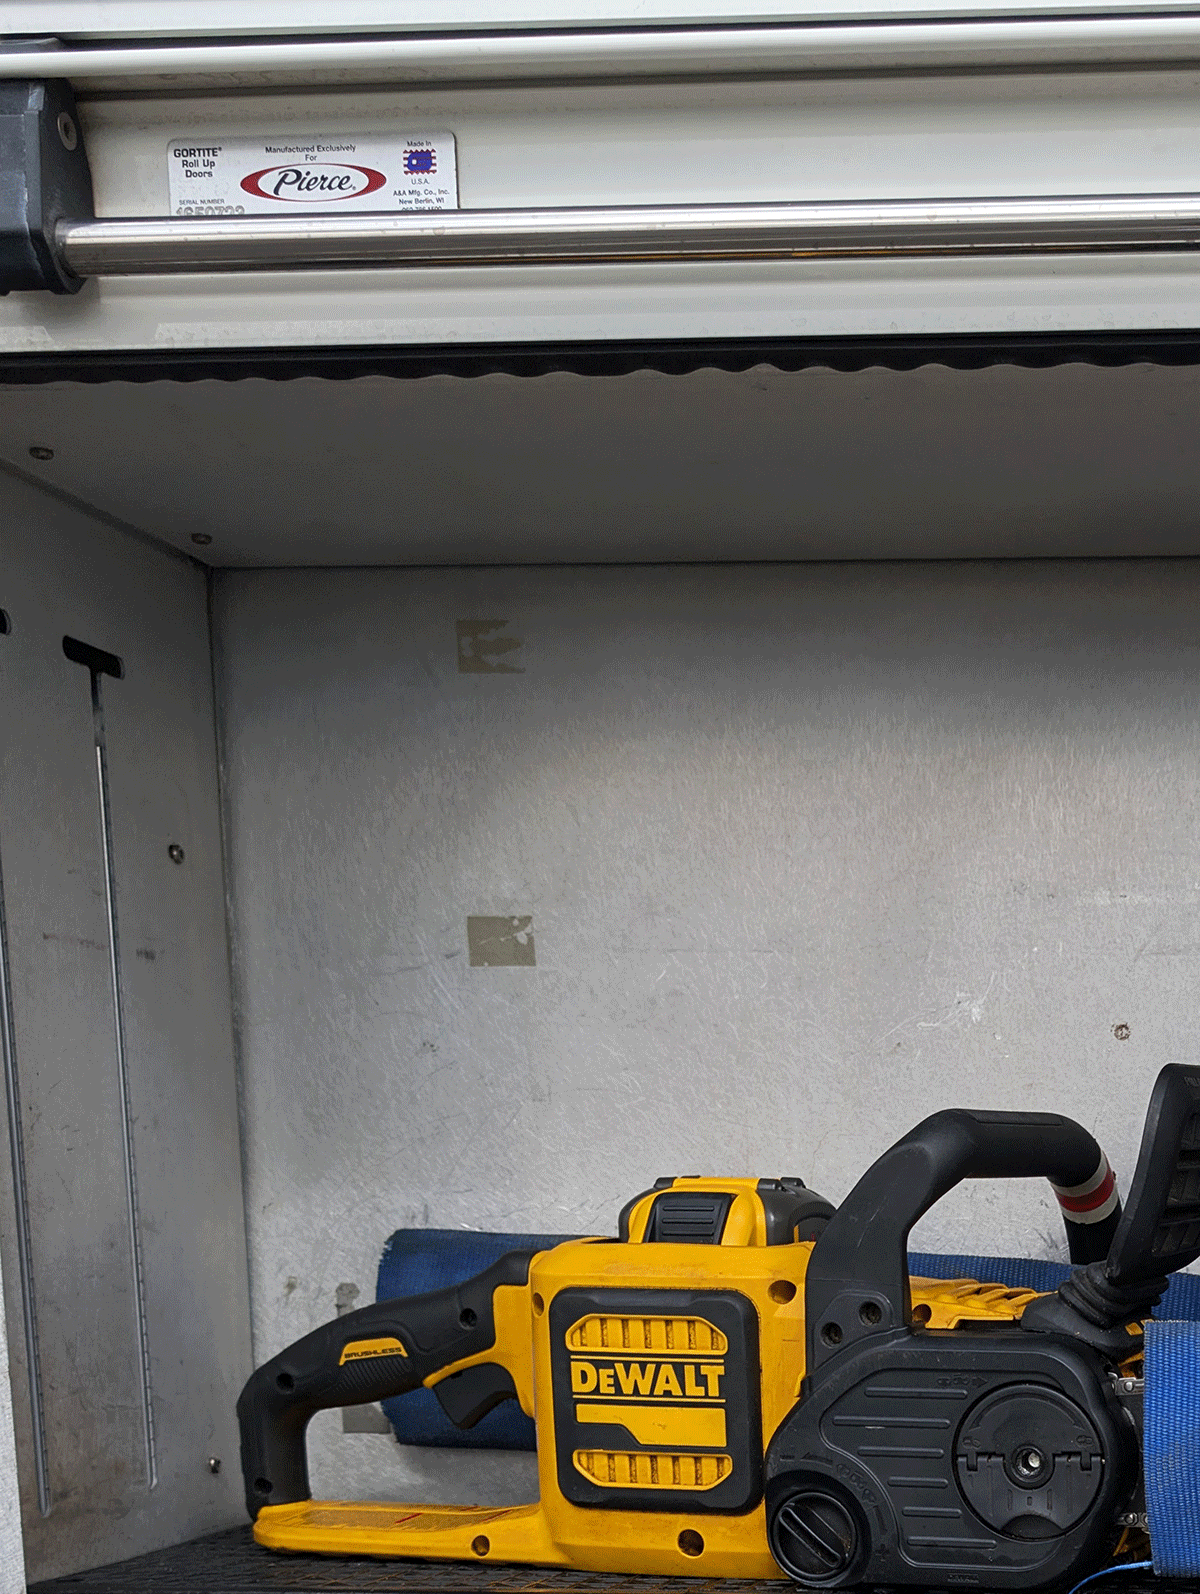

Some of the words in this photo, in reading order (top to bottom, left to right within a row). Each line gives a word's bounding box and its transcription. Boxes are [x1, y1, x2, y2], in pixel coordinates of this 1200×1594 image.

[265, 145, 315, 154] Manufactured
[316, 144, 357, 153] Exclusively
[182, 159, 199, 168] Roll
[202, 159, 216, 169] Up
[185, 169, 213, 178] Doors
[273, 168, 353, 196] Pierce
[344, 1347, 402, 1359] BRUSHLESS
